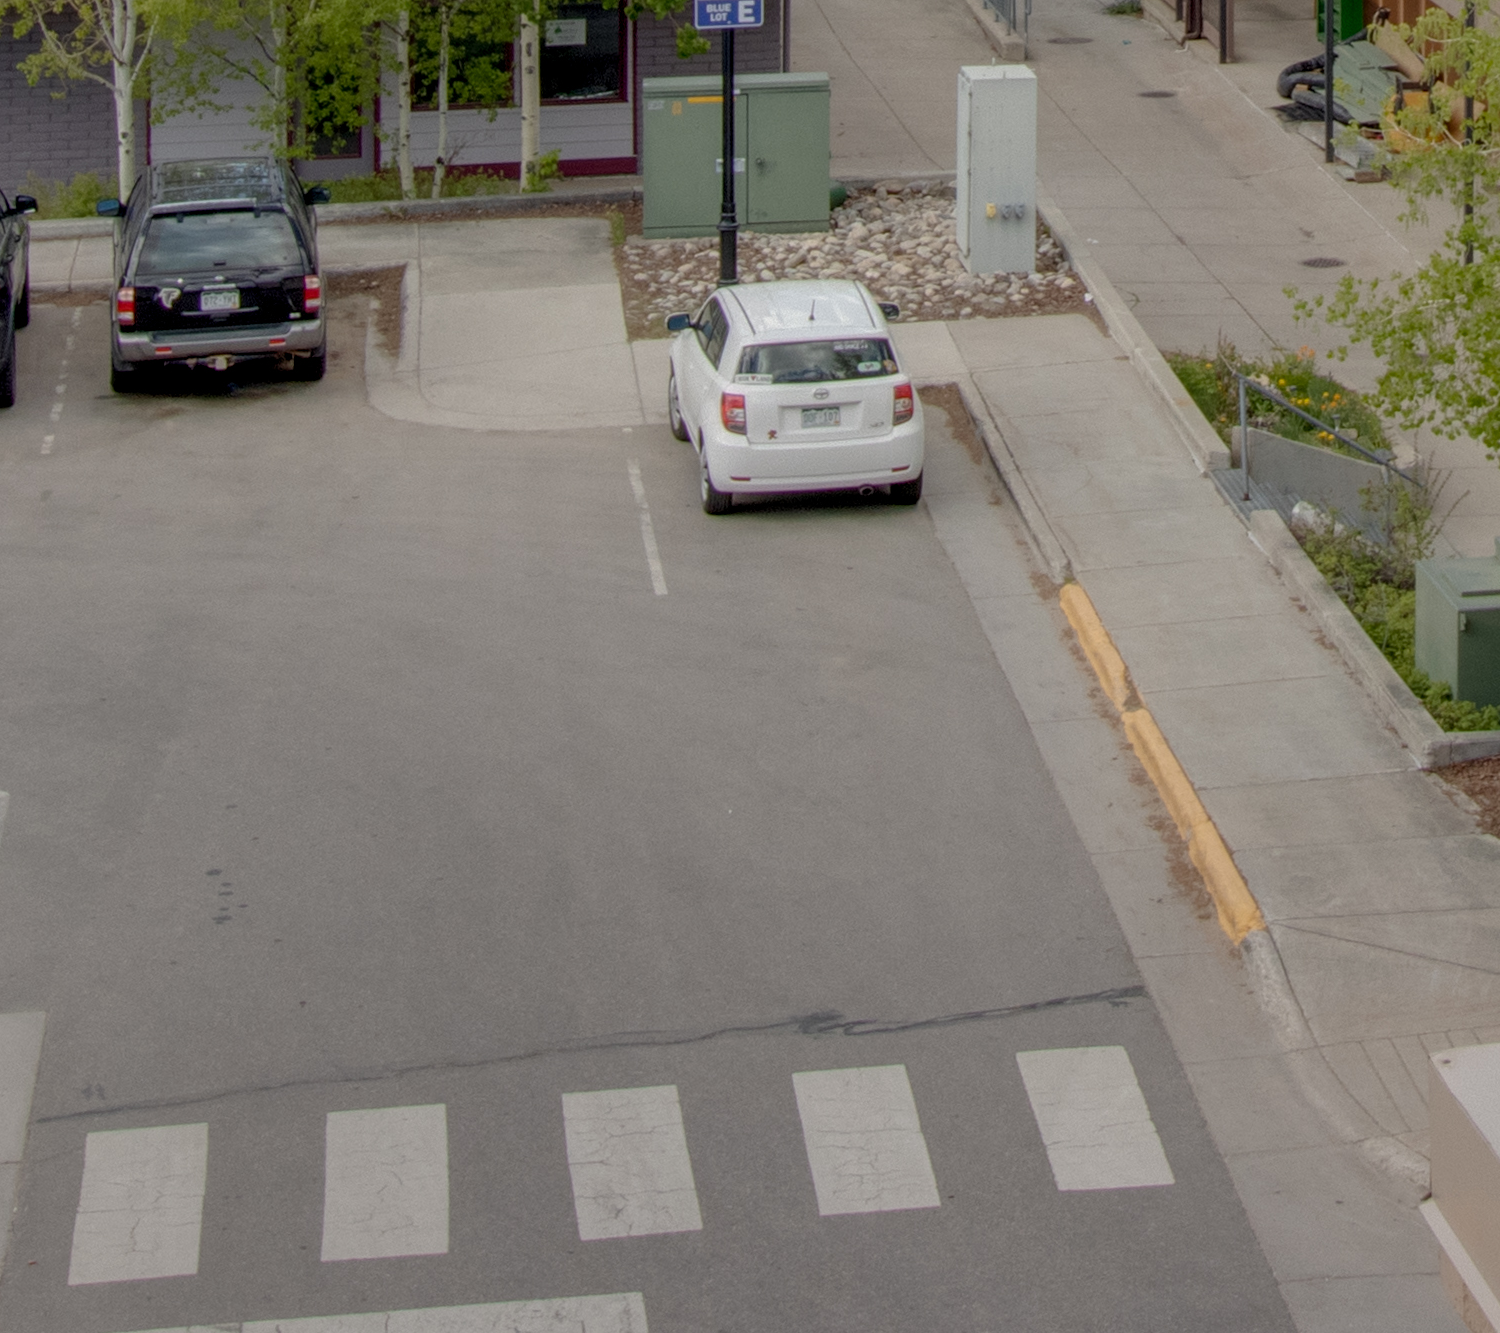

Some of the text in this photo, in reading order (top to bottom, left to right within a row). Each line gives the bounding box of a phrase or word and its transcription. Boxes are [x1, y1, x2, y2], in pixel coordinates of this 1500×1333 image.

[706, 0, 755, 23] BLUE E
[710, 12, 728, 22] LOT
